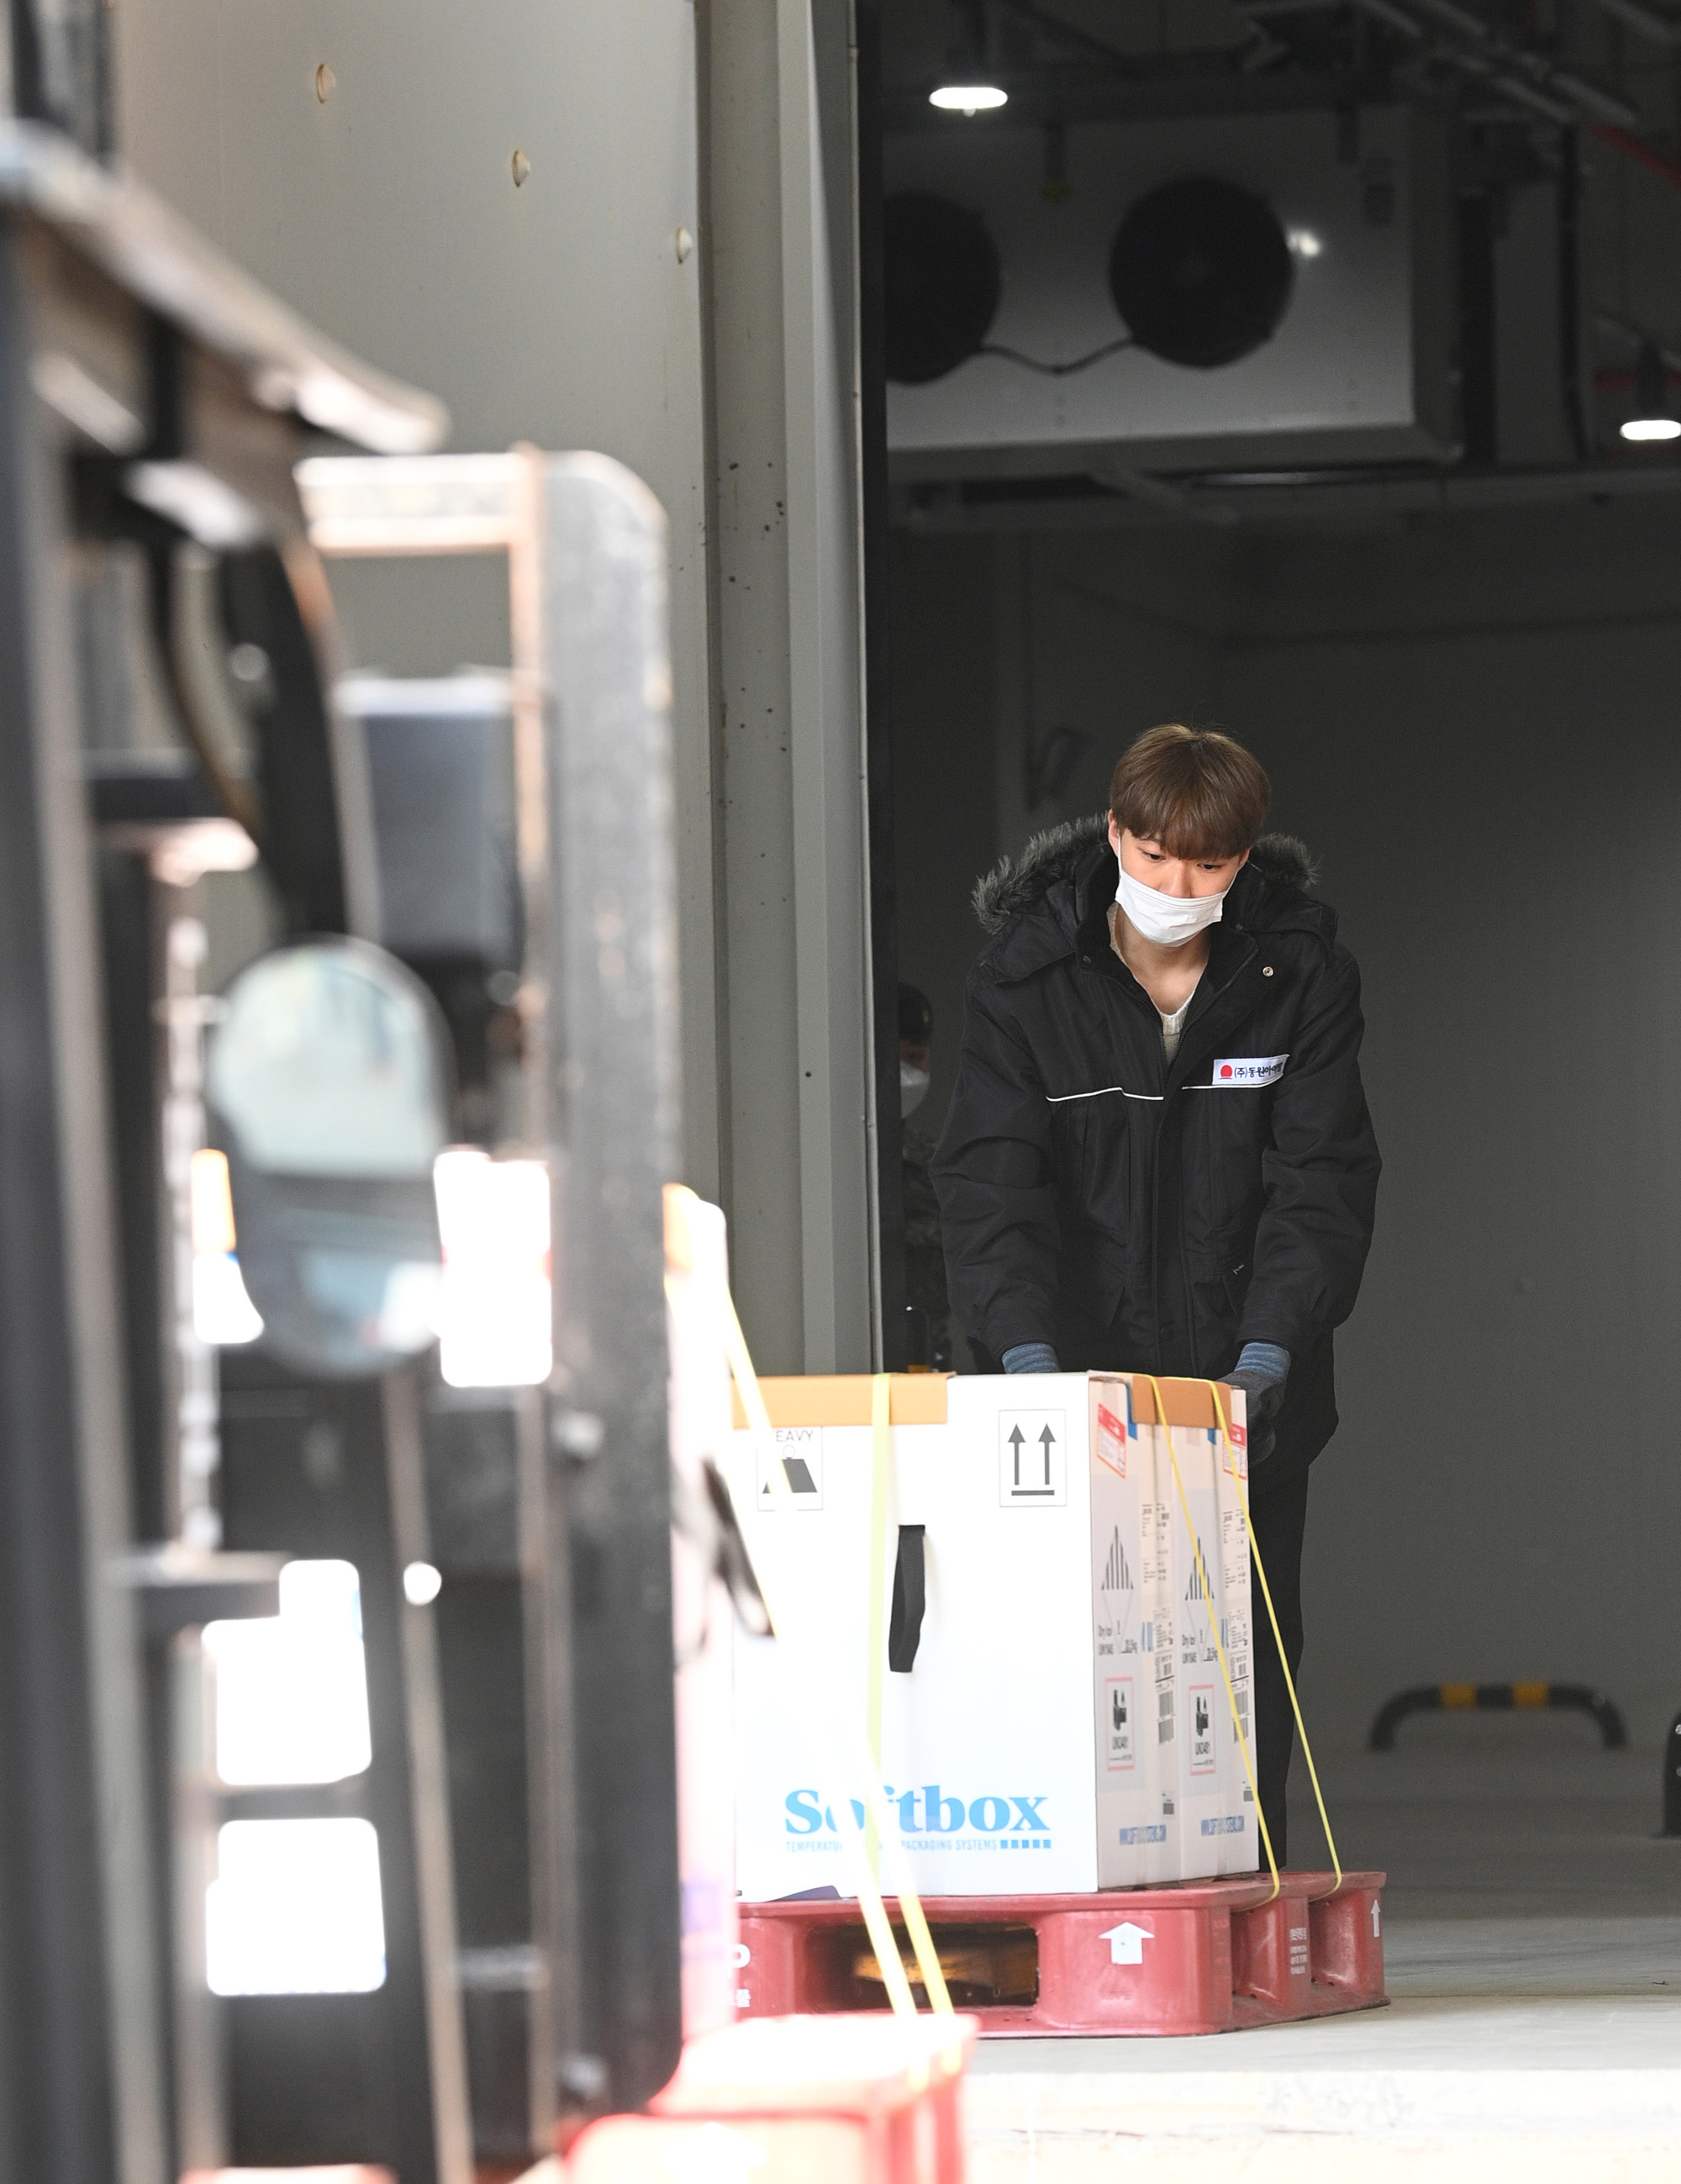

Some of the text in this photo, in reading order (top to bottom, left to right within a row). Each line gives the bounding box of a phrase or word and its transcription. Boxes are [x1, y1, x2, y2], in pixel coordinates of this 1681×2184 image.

[774, 1429, 814, 1443] EAVY
[785, 1785, 1051, 1834] Sotbox
[786, 1840, 843, 1853] TEMPERATU
[901, 1839, 951, 1852] PACKAGING
[956, 1839, 998, 1850] SYSTEMS
